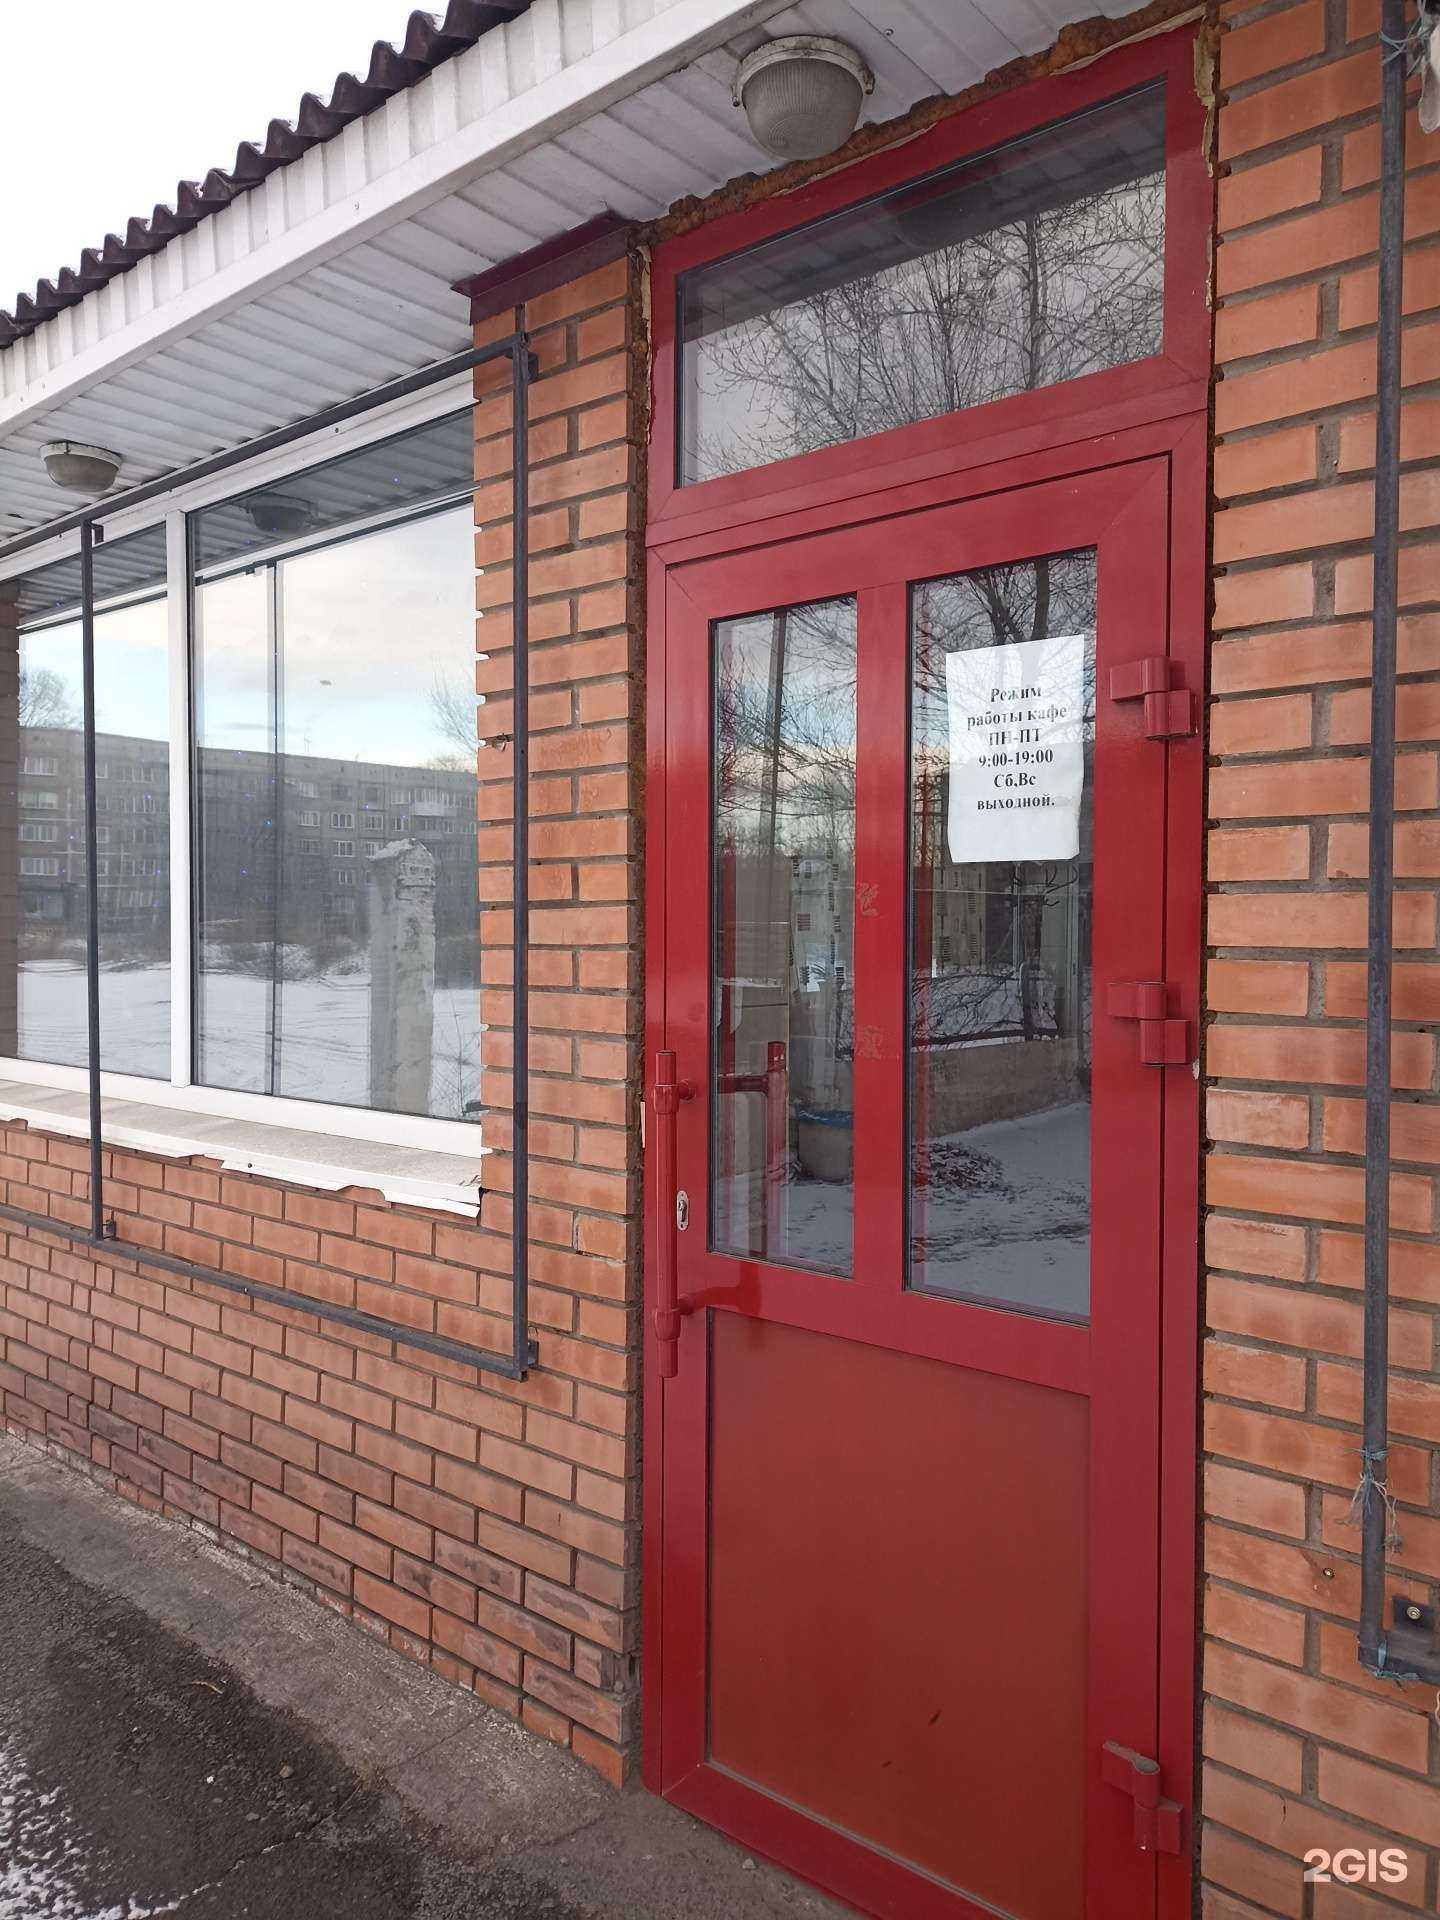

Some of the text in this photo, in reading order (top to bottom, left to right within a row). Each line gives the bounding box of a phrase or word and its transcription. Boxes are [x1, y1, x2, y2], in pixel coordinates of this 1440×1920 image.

[991, 687, 1041, 702] Режим
[967, 704, 1067, 731] работы кафе
[989, 728, 1043, 746] ПН-ПТ
[978, 749, 1054, 767] 9:00-19:00
[977, 793, 1055, 811] выходной.
